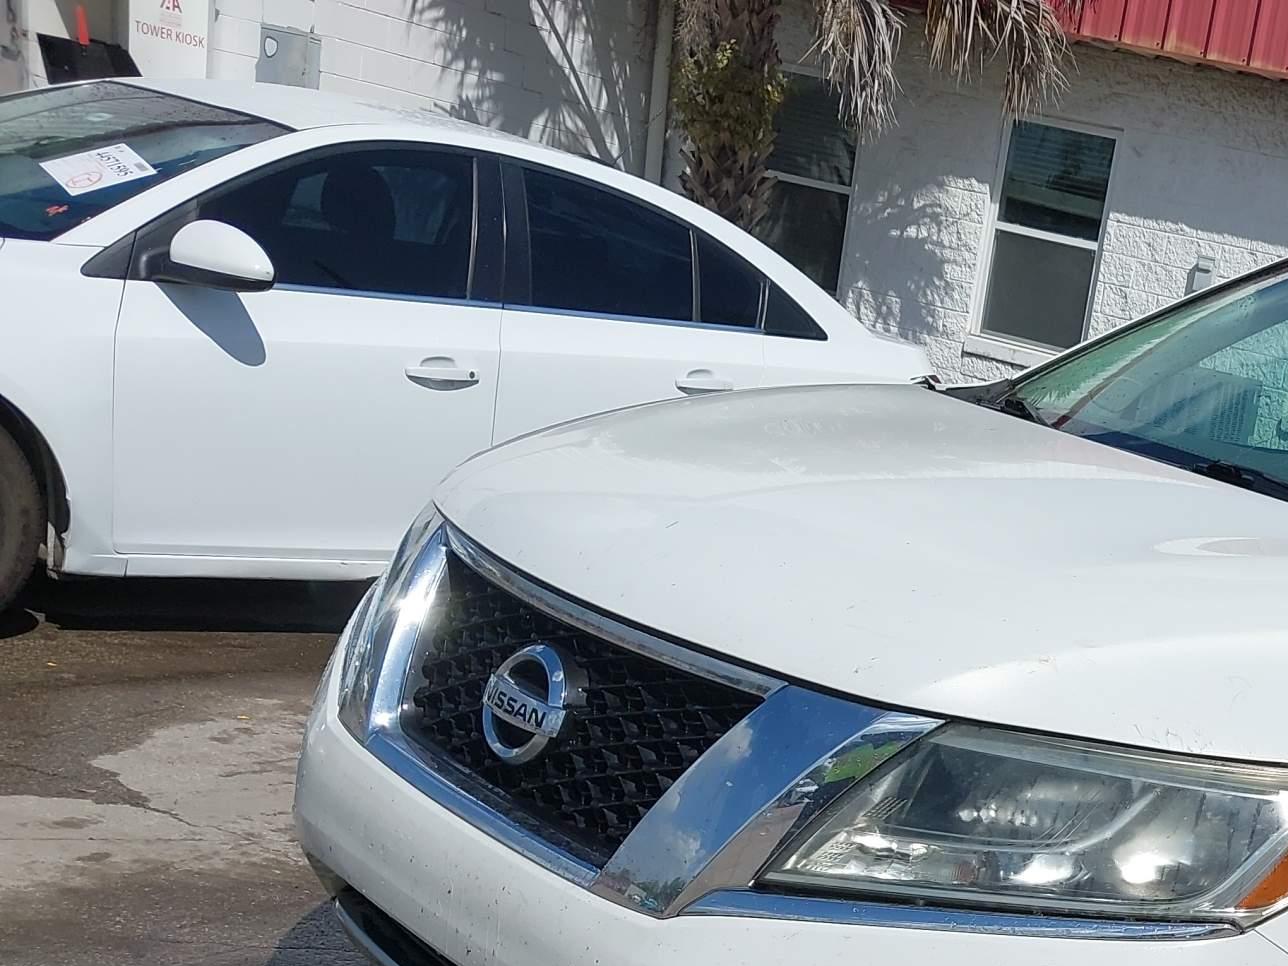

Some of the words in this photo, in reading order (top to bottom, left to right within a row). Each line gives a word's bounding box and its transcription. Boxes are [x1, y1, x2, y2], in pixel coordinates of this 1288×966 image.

[135, 20, 172, 40] TOWER
[175, 31, 205, 48] KIOSK
[486, 679, 547, 729] NISSAN
